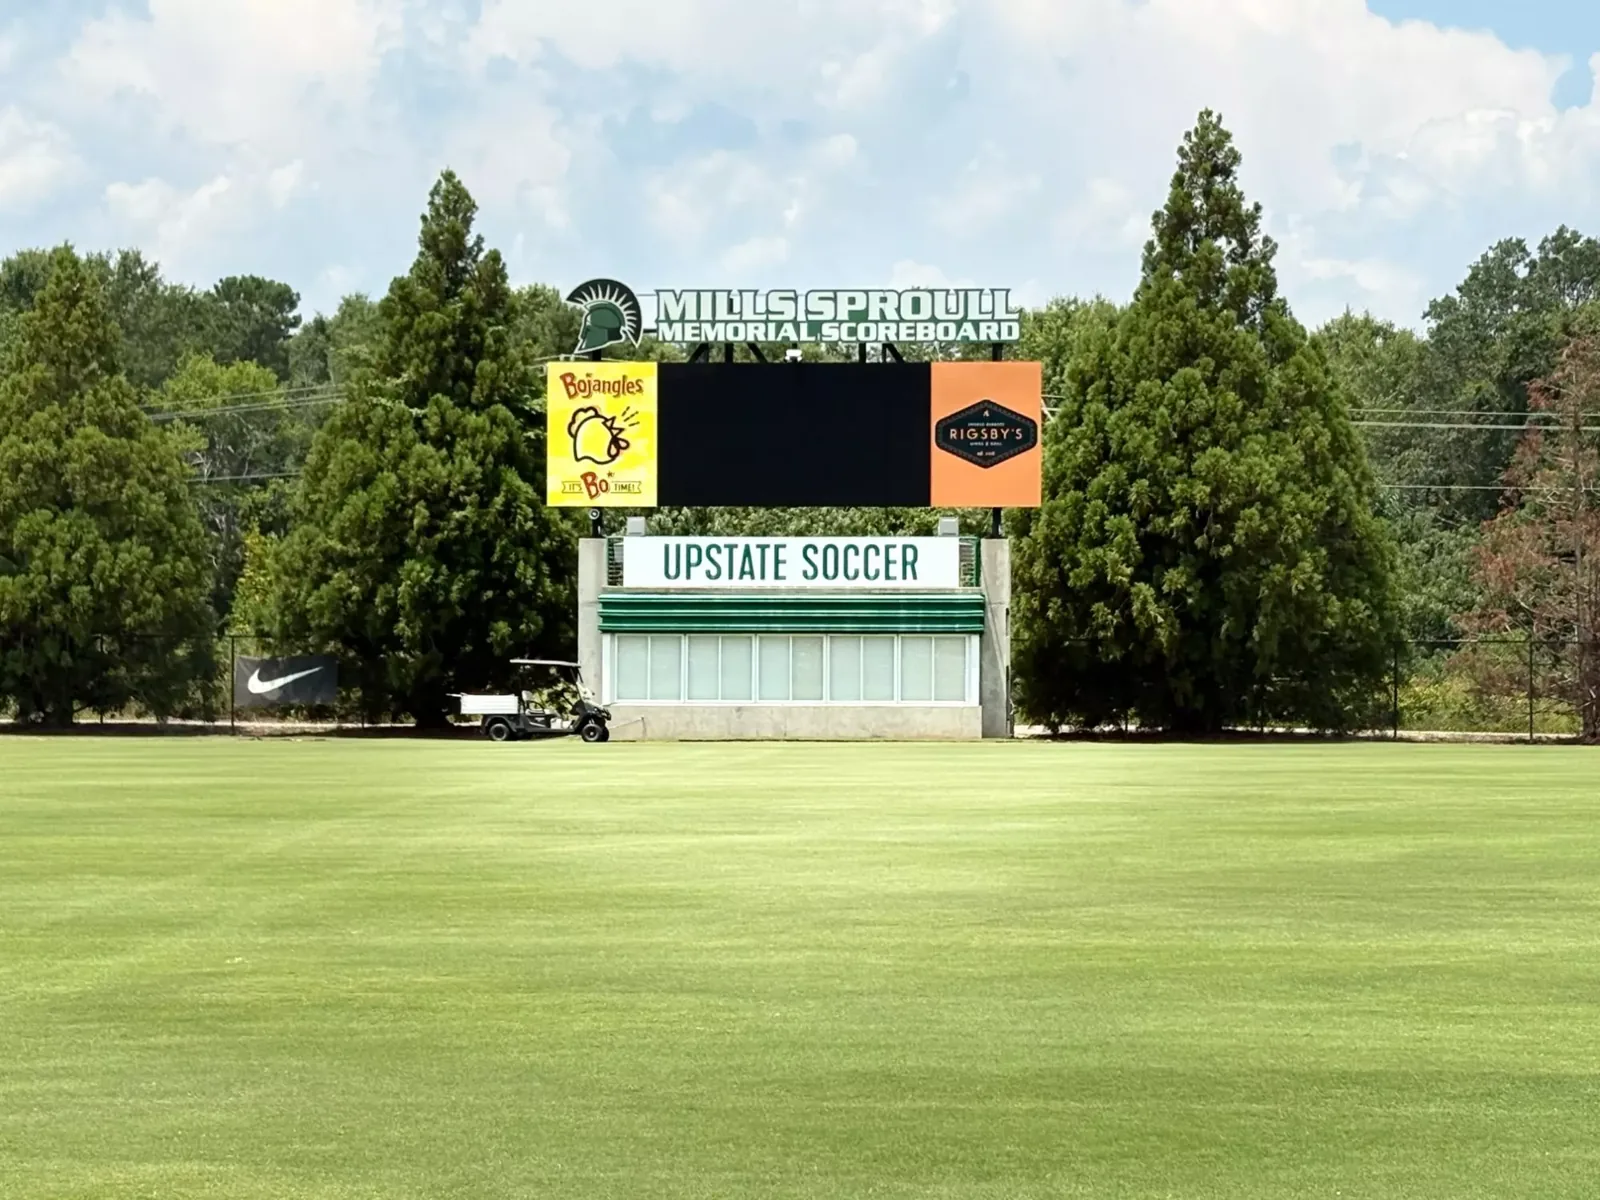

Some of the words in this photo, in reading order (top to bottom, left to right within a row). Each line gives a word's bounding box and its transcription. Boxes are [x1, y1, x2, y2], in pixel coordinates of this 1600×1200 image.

[655, 289, 798, 321] MILLS
[805, 289, 1020, 321] SPROULL
[657, 321, 817, 342] MEMORIAL
[821, 321, 1020, 342] SCOREBOARD
[559, 372, 644, 400] Bojangles
[949, 428, 1023, 440] RIGSBY'S
[663, 543, 787, 581] UPSTATE
[802, 543, 919, 581] SOCCER
